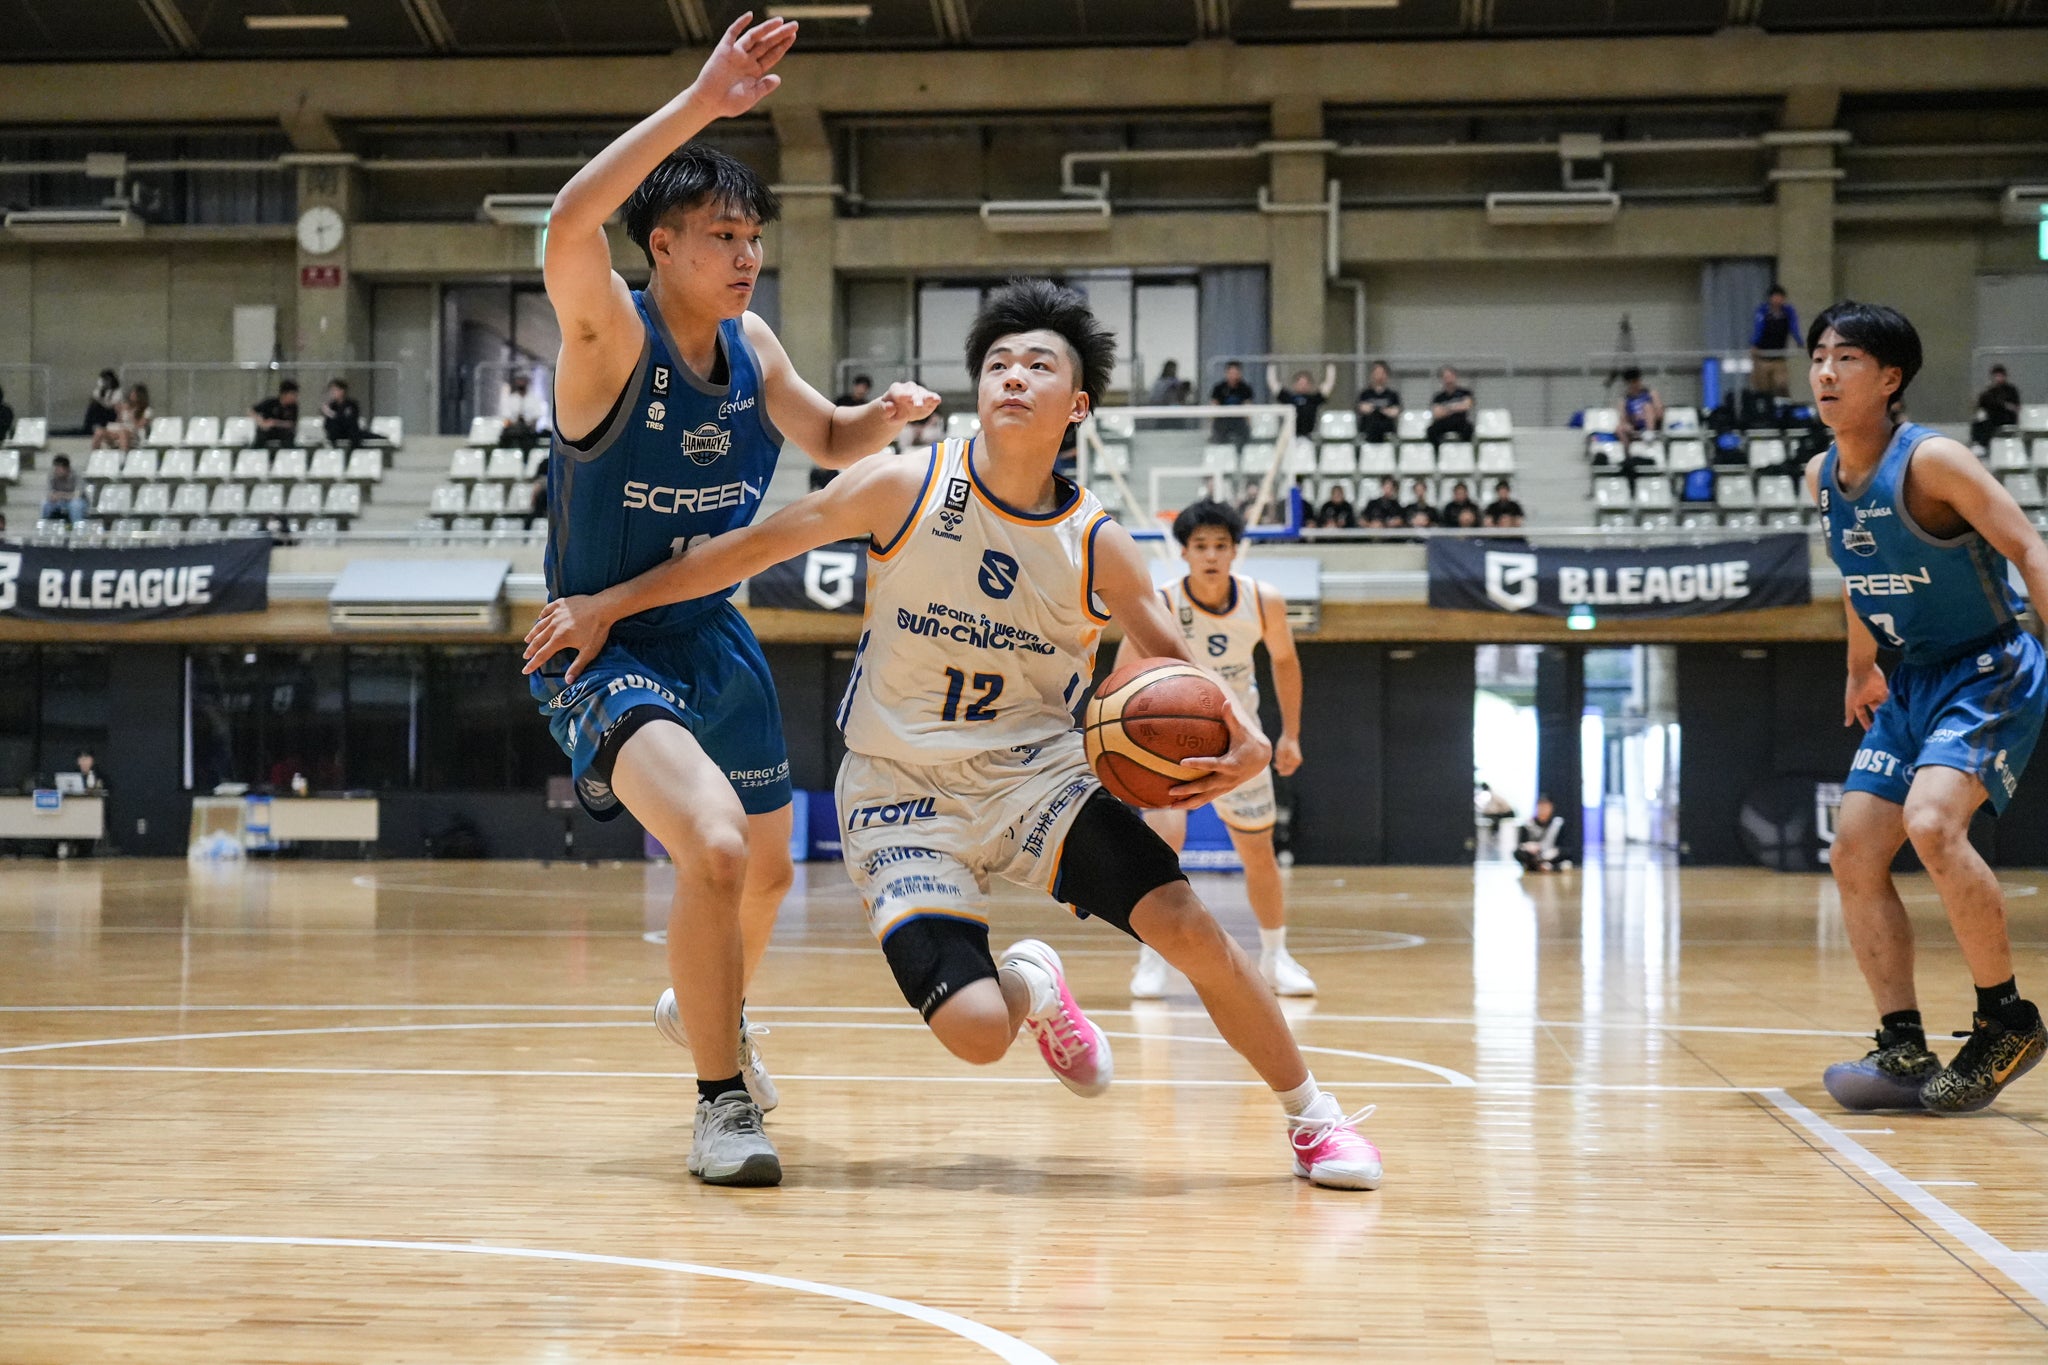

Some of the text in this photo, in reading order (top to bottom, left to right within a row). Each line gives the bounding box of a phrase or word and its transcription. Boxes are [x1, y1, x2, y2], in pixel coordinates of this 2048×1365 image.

[645, 421, 665, 431] TRES
[684, 431, 729, 452] HANNARYZ
[623, 476, 763, 514] SCREEN
[931, 527, 962, 542] hummel
[38, 564, 215, 609] B.LEAGUE
[1559, 559, 1750, 605] B.LEAGUE
[980, 613, 991, 627] is
[941, 664, 1005, 722] 12
[730, 766, 775, 780] ENERGY
[1850, 748, 1901, 777] OST
